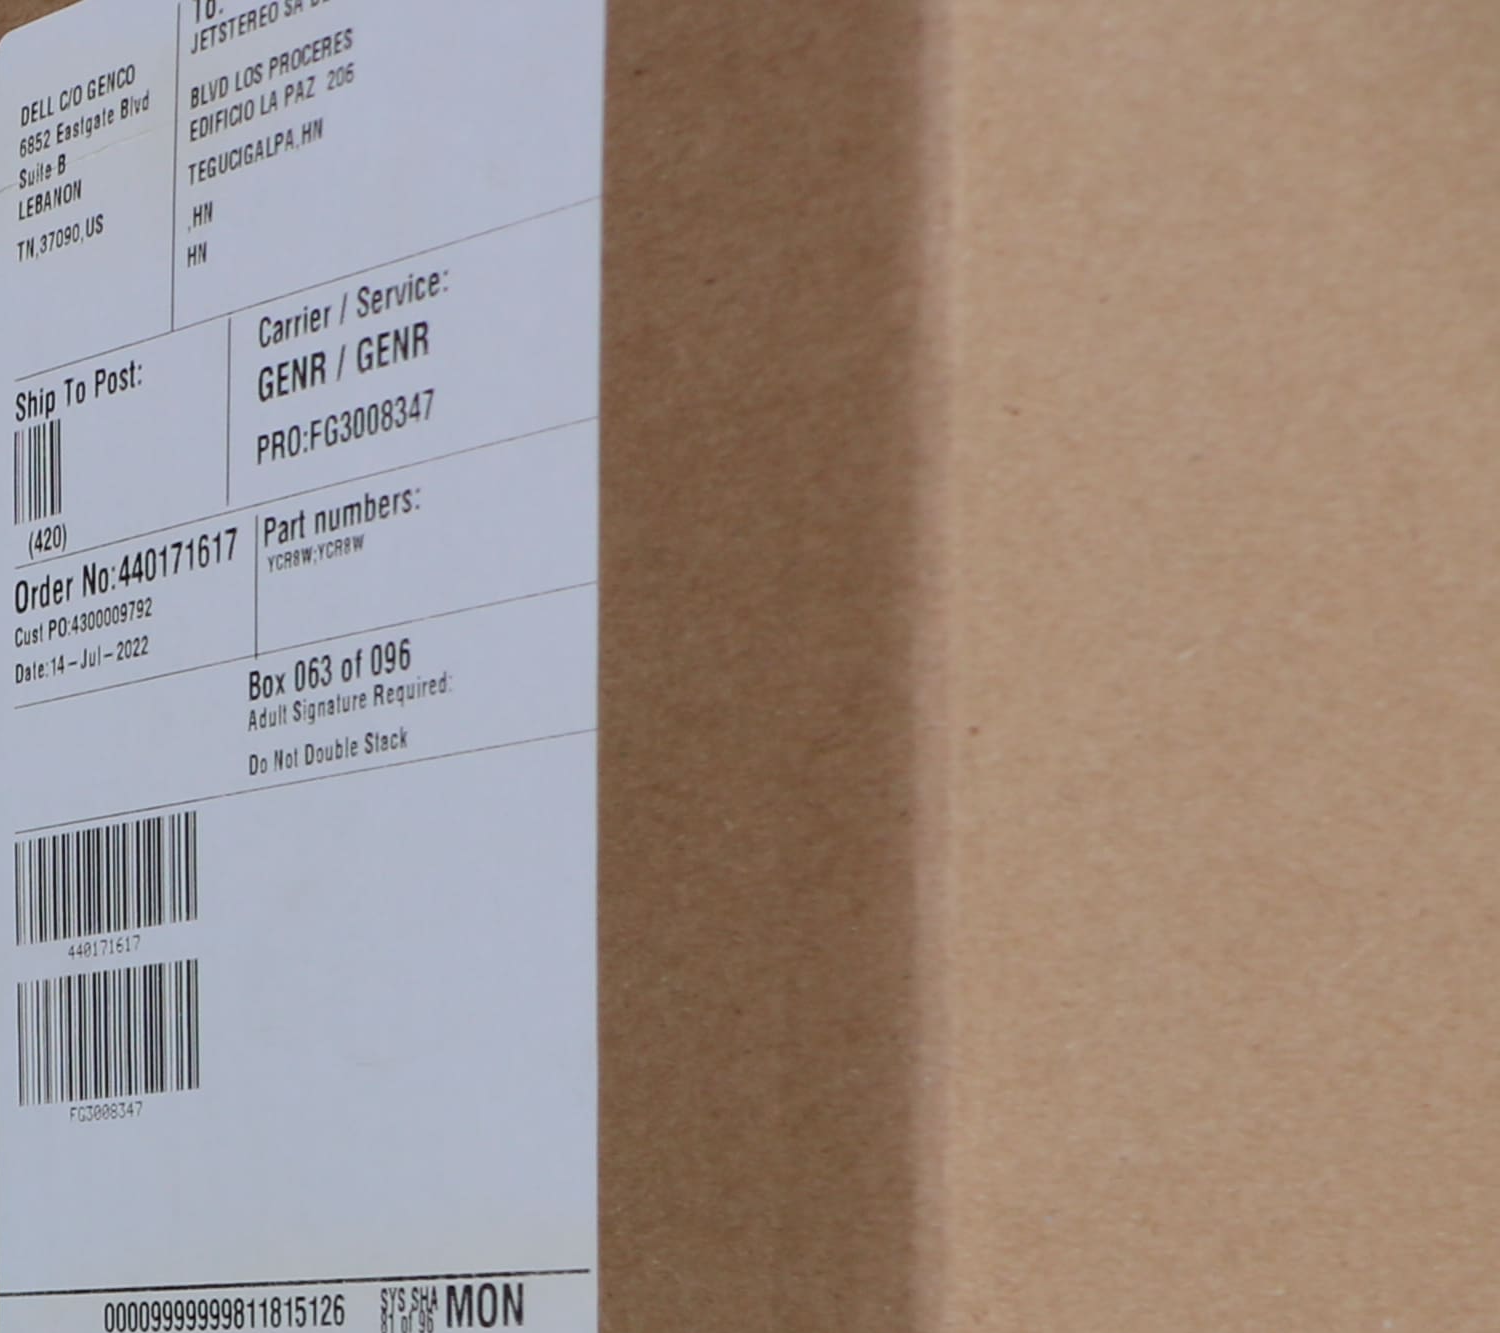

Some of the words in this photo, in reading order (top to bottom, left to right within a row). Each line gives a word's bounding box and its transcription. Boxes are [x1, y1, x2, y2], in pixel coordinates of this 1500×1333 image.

[191, 1, 278, 54] JETSTEREO
[21, 91, 54, 127] DELL
[59, 84, 83, 113] C/O
[87, 64, 136, 103] GENCO
[190, 71, 230, 109] BLVD
[235, 63, 264, 96] LOS
[268, 27, 353, 80] PROCERES
[19, 129, 51, 158] 6852
[56, 107, 114, 146] Eastgate
[120, 90, 151, 121] Blvd
[189, 100, 255, 142] EDIFICIO
[259, 89, 280, 117] LA
[284, 76, 316, 111] PAZ
[327, 62, 356, 92] 206
[18, 179, 82, 221] LEBANON
[258, 300, 331, 349] Carrier
[356, 267, 449, 322] Service:
[15, 379, 56, 426] Ship
[64, 375, 87, 406] To
[94, 359, 143, 400] Post:
[257, 349, 327, 403] GENR
[356, 320, 431, 376] GENR
[257, 388, 436, 465] PRO:FG3008347
[264, 507, 307, 548] Part
[314, 487, 421, 537] numbers:
[15, 566, 74, 616] Order
[81, 527, 238, 600] No:440171617
[248, 668, 286, 701] Box
[294, 654, 334, 693] 063
[341, 647, 364, 680] of
[370, 637, 412, 674] 096
[248, 753, 268, 776] Do
[273, 747, 300, 771] Not
[304, 734, 360, 766] Double
[364, 727, 408, 757] Stack
[446, 1283, 525, 1328] MON
